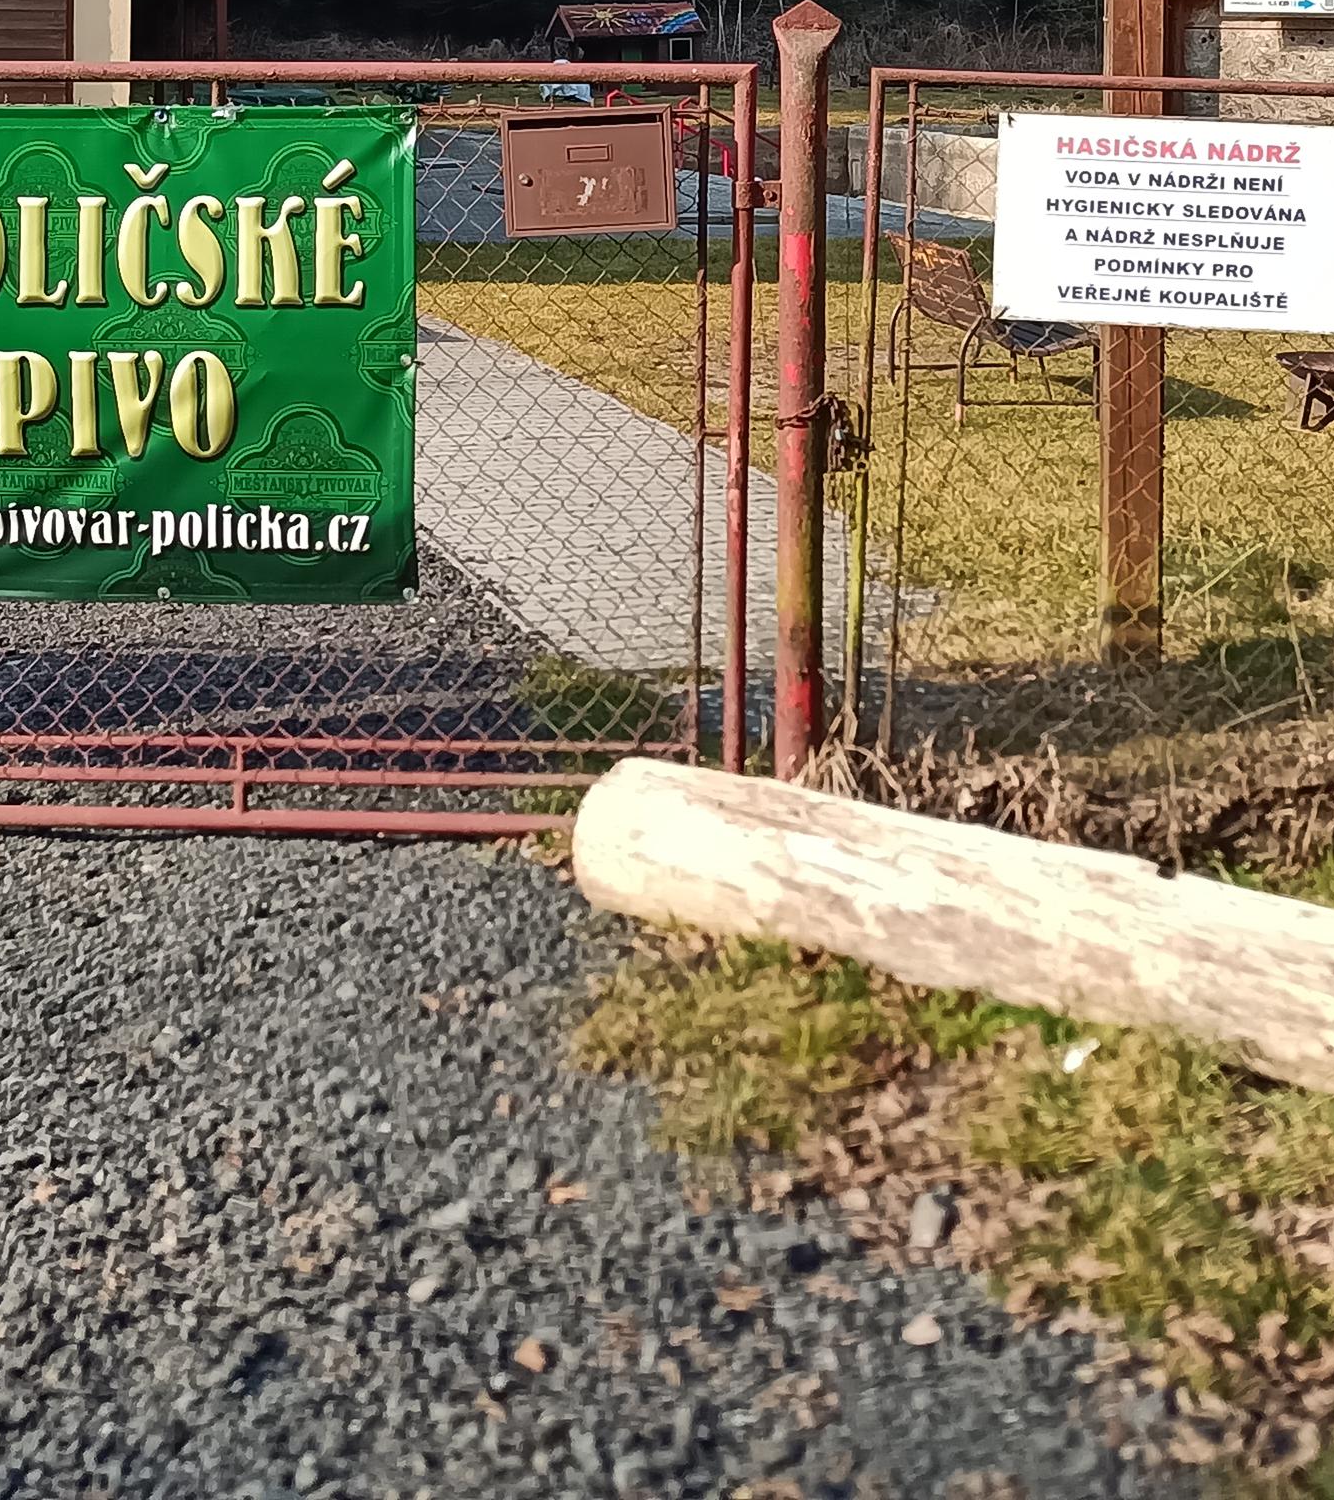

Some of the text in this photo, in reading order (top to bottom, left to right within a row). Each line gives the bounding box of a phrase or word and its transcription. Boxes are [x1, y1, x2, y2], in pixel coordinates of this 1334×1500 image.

[1056, 136, 1302, 164] HASIČSKÁ NÁDRŽ
[1065, 170, 1284, 192] VODA V NÁDRŽI NENÍ
[1046, 198, 1307, 223] HYGIENICKY SLEDOVÁNA
[1065, 227, 1285, 251] A NÁDRŽ NESPLŇUJE
[1094, 257, 1254, 278] PODMÍNKY PRO
[1057, 285, 1289, 310] VEŘEJNÉ KOUPALIŠTĚ
